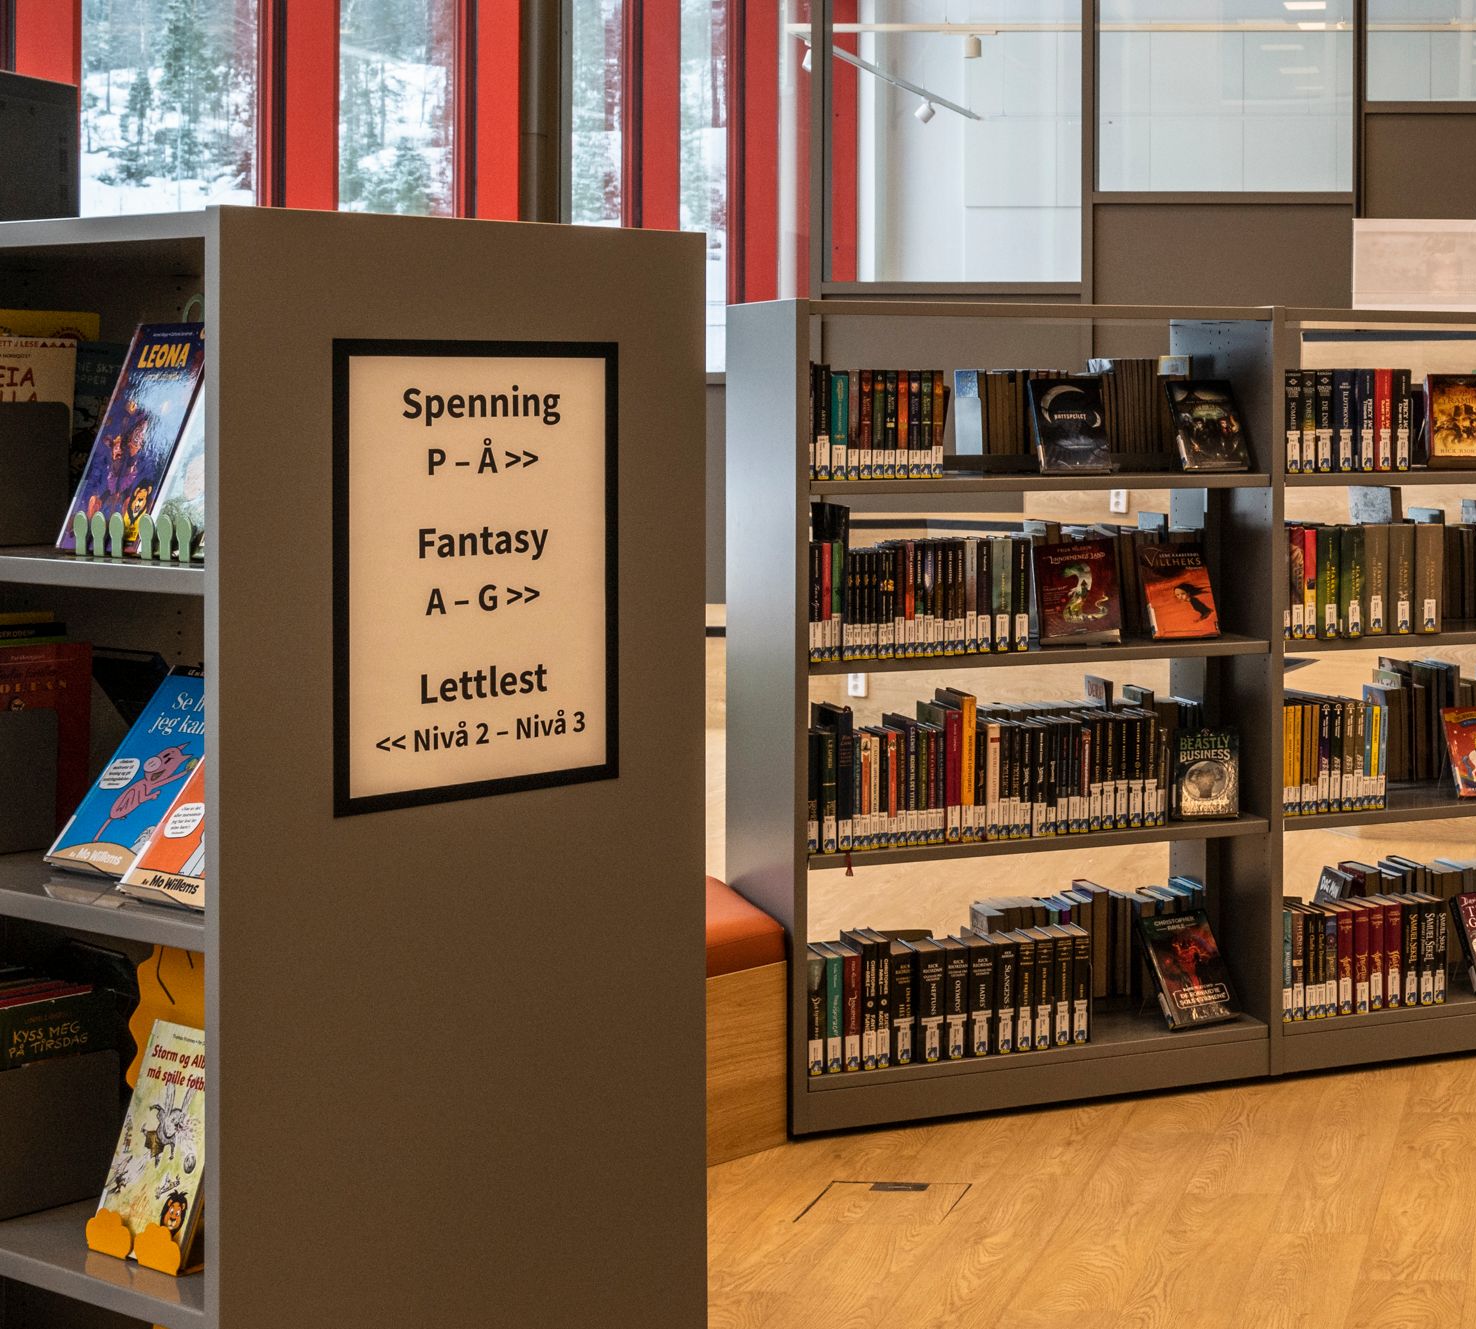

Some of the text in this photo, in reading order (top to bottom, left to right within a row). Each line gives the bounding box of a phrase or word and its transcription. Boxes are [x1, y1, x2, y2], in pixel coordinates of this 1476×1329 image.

[137, 343, 191, 369] LEONA
[402, 385, 560, 426] Spenning
[428, 449, 446, 475] P
[478, 438, 498, 474] Å
[418, 526, 548, 560] Fantasy
[1144, 547, 1202, 568] VILLHEKS
[426, 588, 446, 616] A
[478, 584, 498, 612] G
[420, 664, 547, 704] Lettlest
[172, 691, 193, 712] Se
[148, 712, 180, 736] jeg
[414, 721, 469, 753] Nivå
[475, 722, 489, 745] 2
[516, 709, 566, 740] Nivå
[573, 711, 586, 733] 3
[1179, 735, 1231, 764] BEASTLY BUSINESS
[150, 874, 200, 896] Mo Willems
[1425, 912, 1436, 941] SAMUEL
[48, 1020, 81, 1039] MEG
[152, 1044, 179, 1062] Storm
[179, 1054, 191, 1069] og
[147, 1066, 205, 1092] må spille fotb
